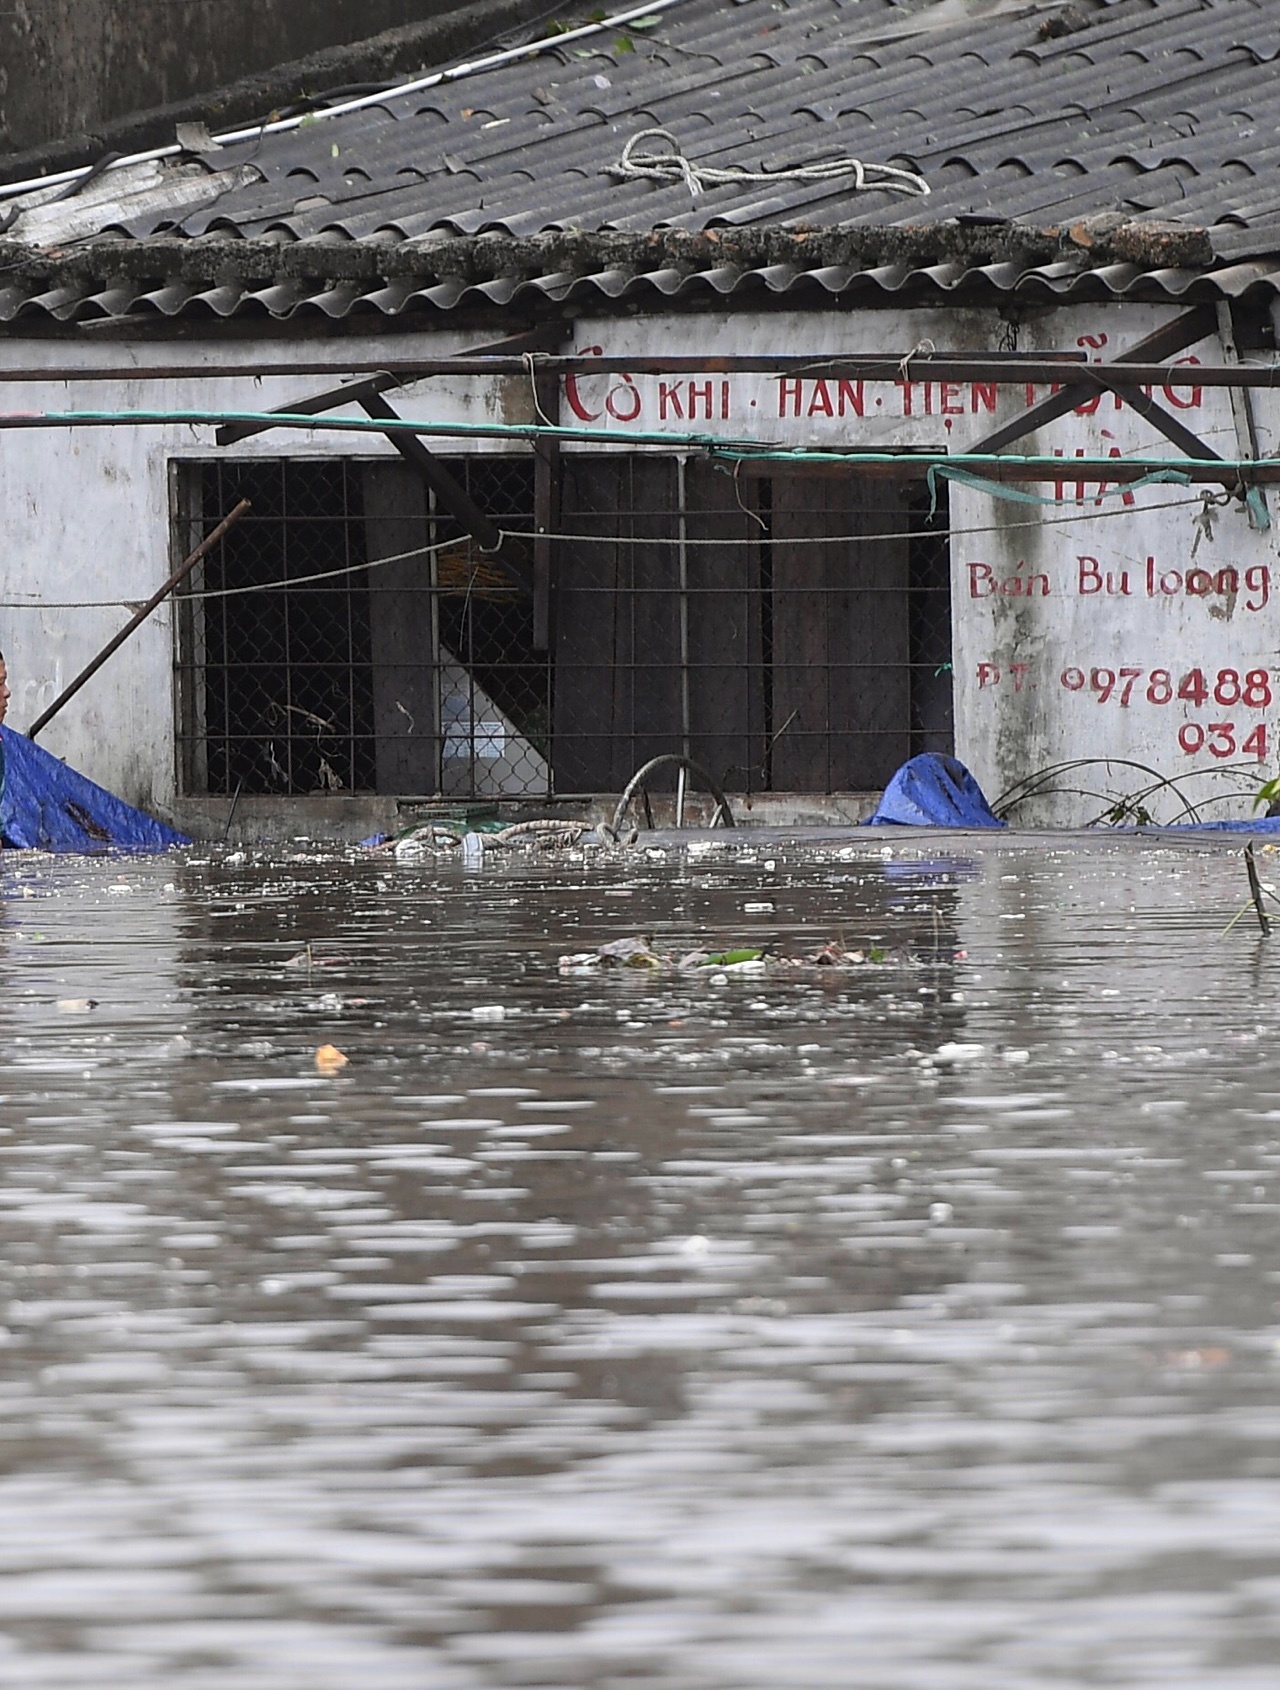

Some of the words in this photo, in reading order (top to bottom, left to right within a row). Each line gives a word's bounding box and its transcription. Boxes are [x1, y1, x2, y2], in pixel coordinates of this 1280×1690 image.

[966, 561, 1050, 599] Bán
[1060, 667, 1272, 709] 0978488
[1178, 722, 1270, 761] 034
